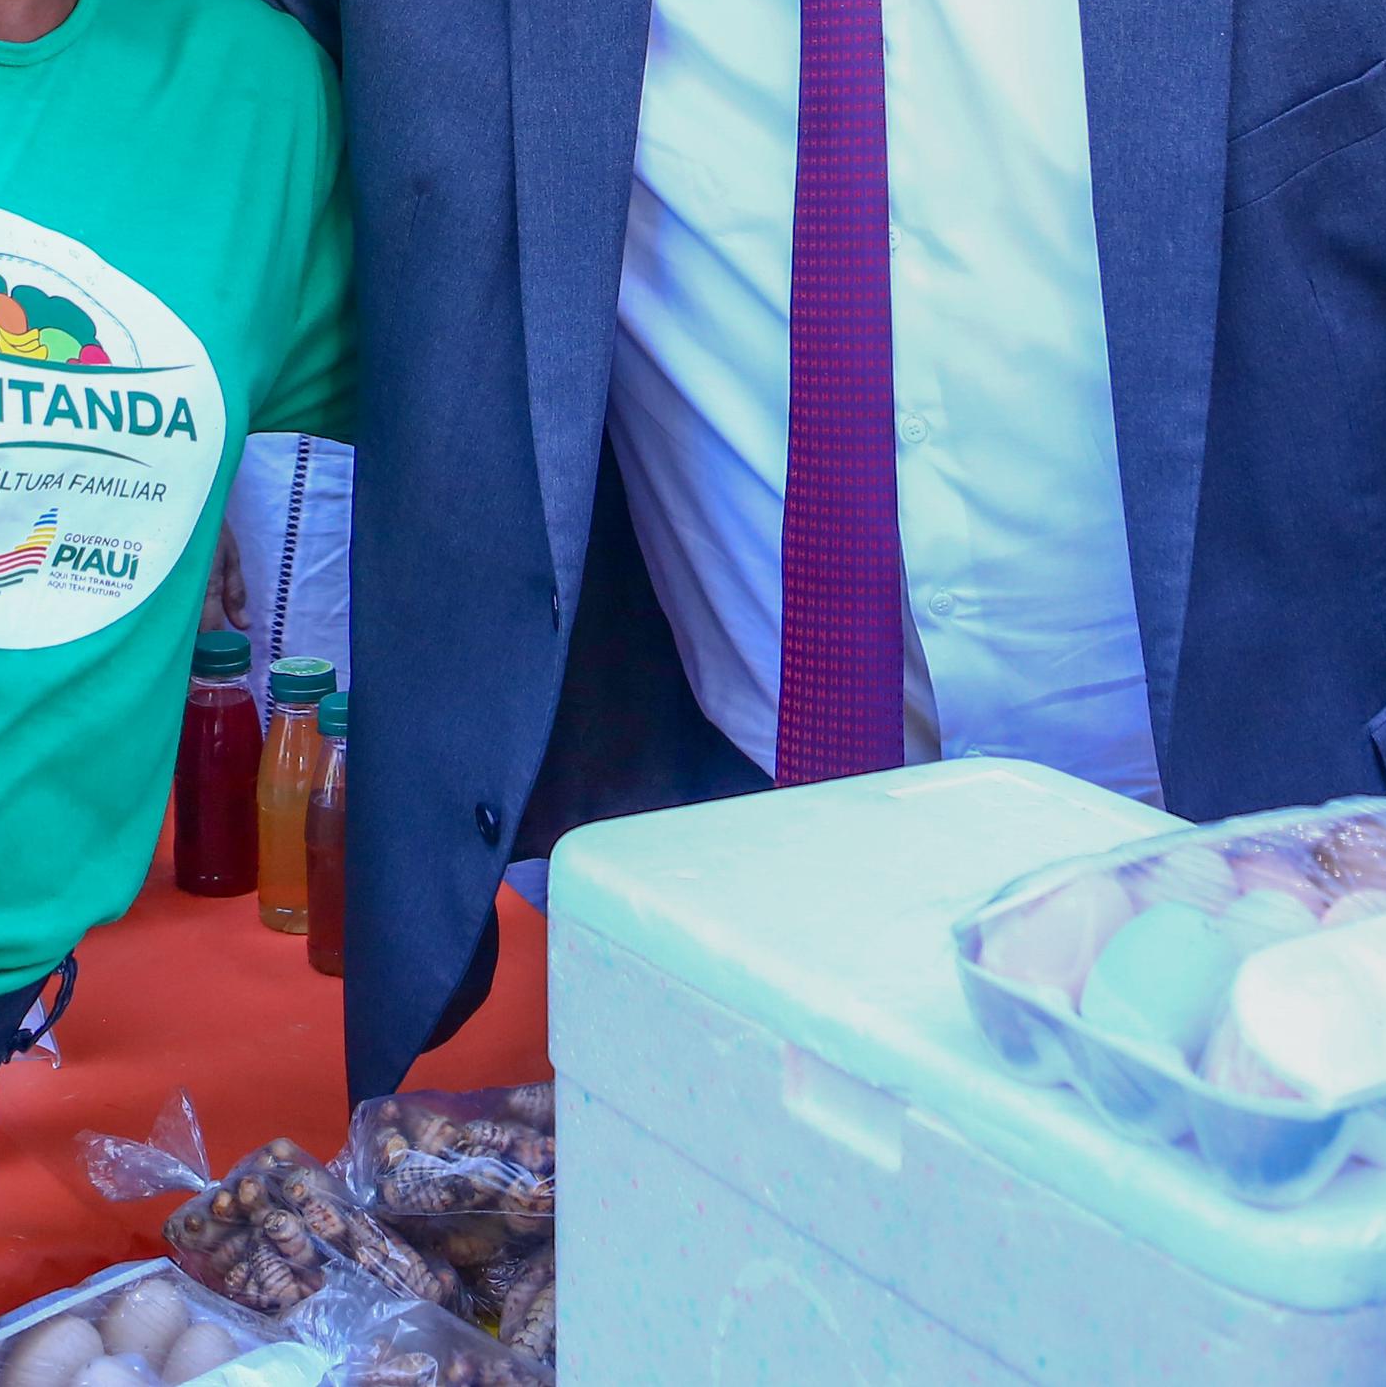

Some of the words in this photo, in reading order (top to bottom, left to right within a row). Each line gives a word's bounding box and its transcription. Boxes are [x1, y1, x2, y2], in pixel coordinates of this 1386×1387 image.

[68, 473, 167, 502] FAMILIAR
[64, 533, 119, 548] GOVERNO
[123, 540, 143, 552] DO
[51, 543, 139, 580] PIAUÍ
[47, 580, 67, 589] AQUI
[69, 582, 85, 591] TEM
[87, 586, 121, 598] FUTURO
[49, 571, 68, 579] AQUI
[70, 573, 86, 582] TEM
[89, 576, 133, 590] TRABALHO
